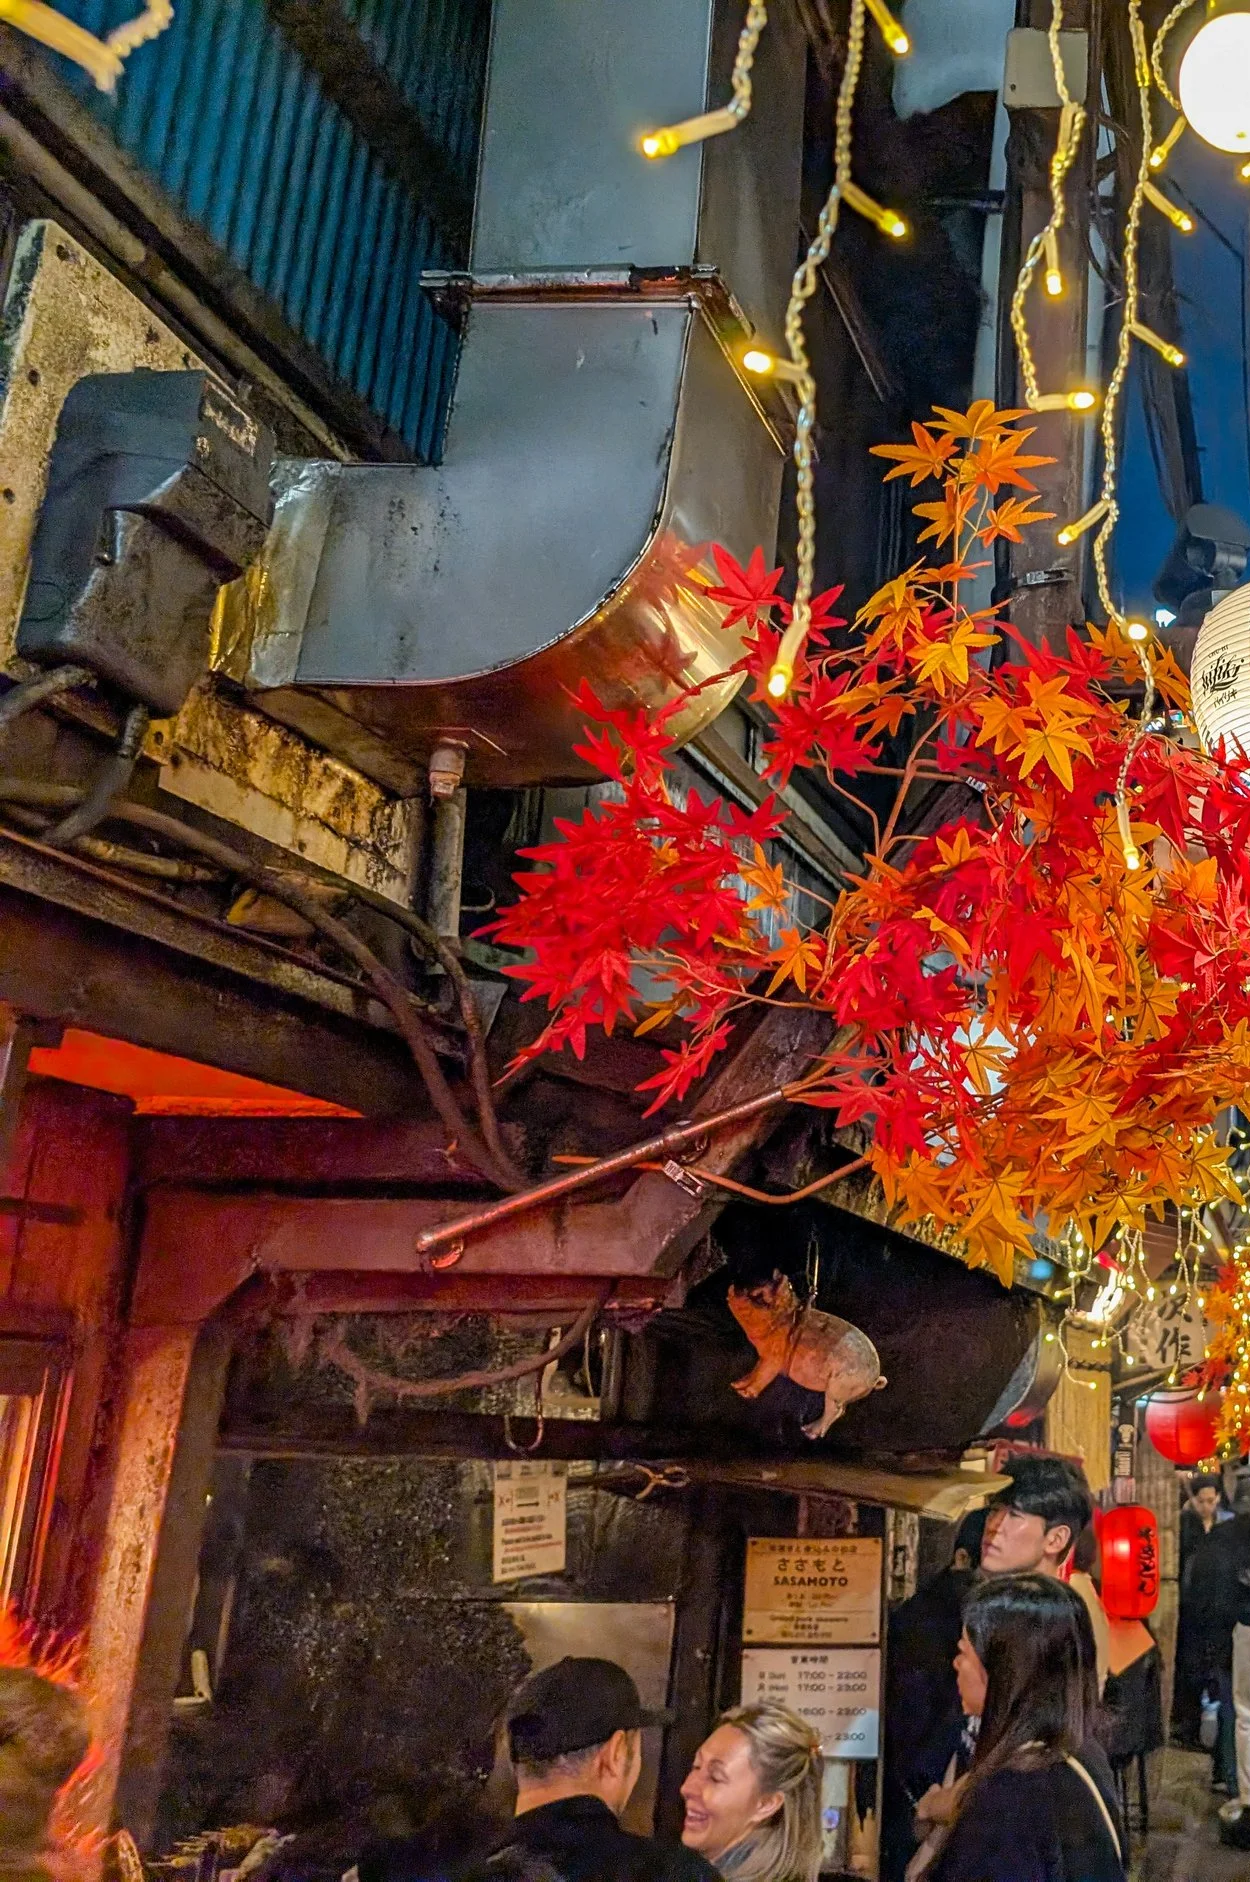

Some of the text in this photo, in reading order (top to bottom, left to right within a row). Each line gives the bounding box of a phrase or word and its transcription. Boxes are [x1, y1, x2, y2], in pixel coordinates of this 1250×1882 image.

[773, 1576, 849, 1587] SASAMOTO
[798, 1671, 826, 1680] 17:00
[798, 1683, 826, 1692] 17:00
